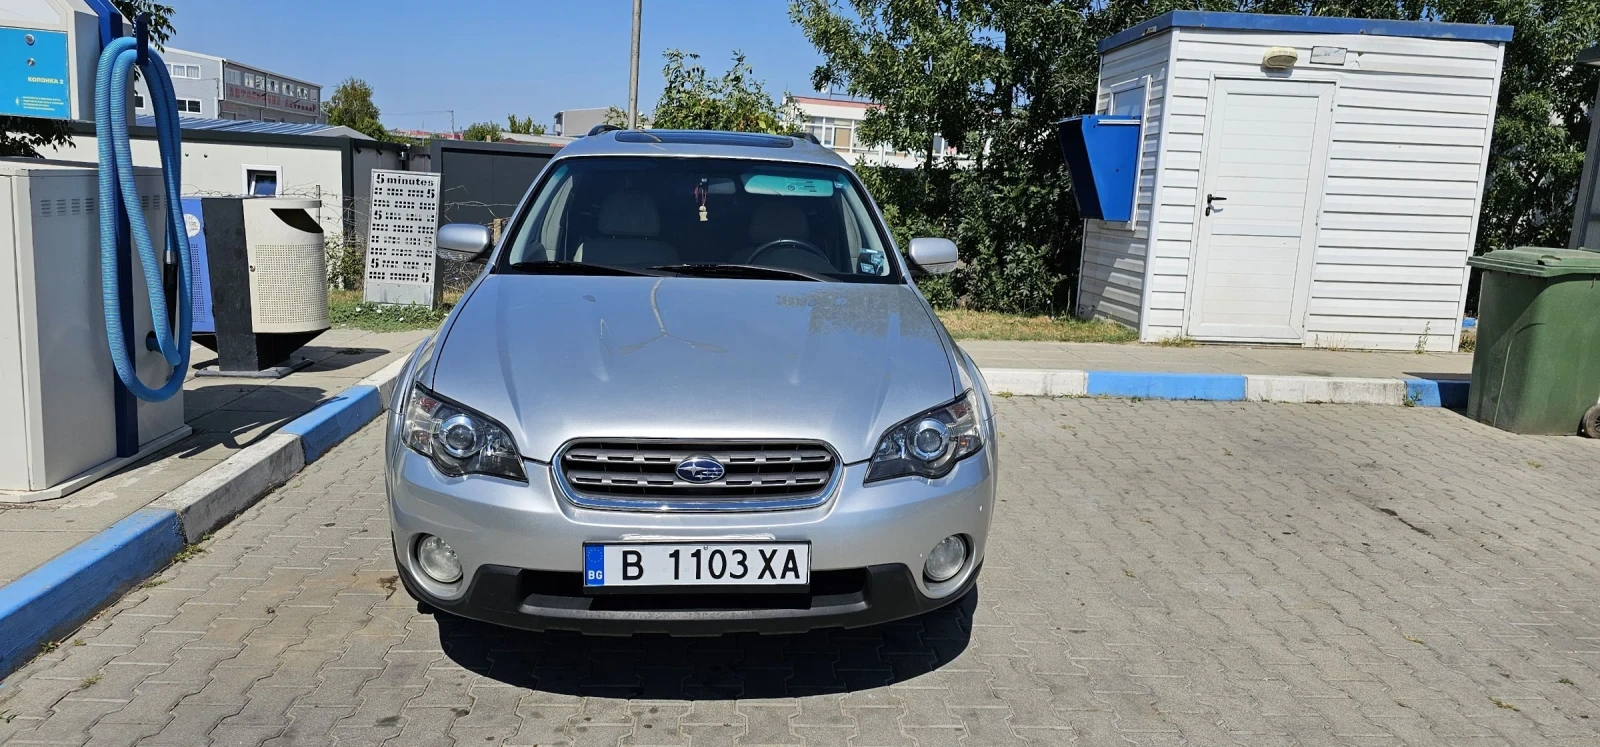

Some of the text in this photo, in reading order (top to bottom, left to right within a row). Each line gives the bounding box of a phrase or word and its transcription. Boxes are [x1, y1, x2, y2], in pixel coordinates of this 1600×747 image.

[376, 173, 434, 186] 5 minutes
[426, 188, 435, 199] 5
[373, 210, 382, 220] 5
[370, 258, 379, 268] 5
[421, 272, 430, 283] 5
[622, 549, 800, 580] B 1103 XA
[588, 570, 603, 580] BG
